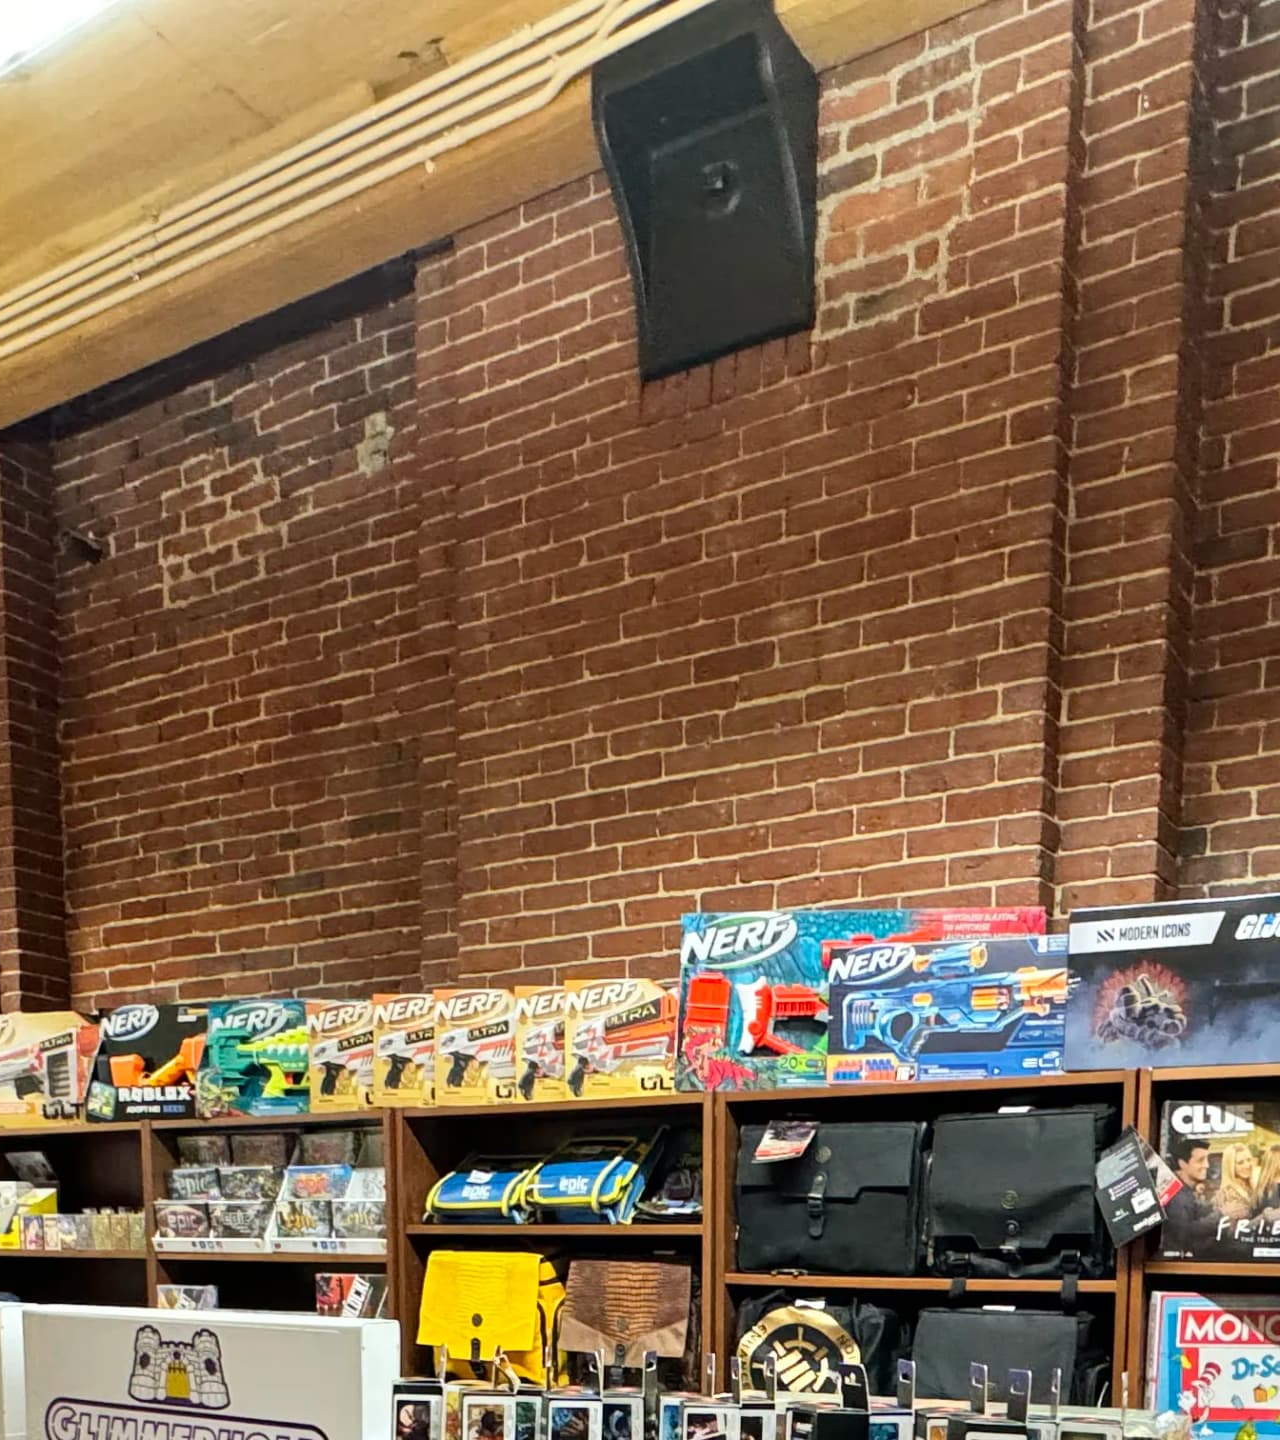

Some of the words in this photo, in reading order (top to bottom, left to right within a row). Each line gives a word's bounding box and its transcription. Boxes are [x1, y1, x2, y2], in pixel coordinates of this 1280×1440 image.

[682, 914, 794, 965] NERF
[1119, 924, 1158, 942] MODERN
[1160, 922, 1192, 940] ICONS
[828, 942, 907, 983] NERF
[434, 991, 504, 1026] NERF
[566, 981, 637, 1013] NERF
[101, 1006, 156, 1037] NERF
[212, 1002, 286, 1031] NERF
[308, 1004, 368, 1033] NERF
[606, 1003, 657, 1028] ULTRA
[469, 1022, 509, 1041] ULTRA
[119, 1086, 195, 1101] ROBLOX
[1171, 1104, 1254, 1134] CLUE
[559, 1176, 589, 1193] epic
[168, 1214, 199, 1231] epic
